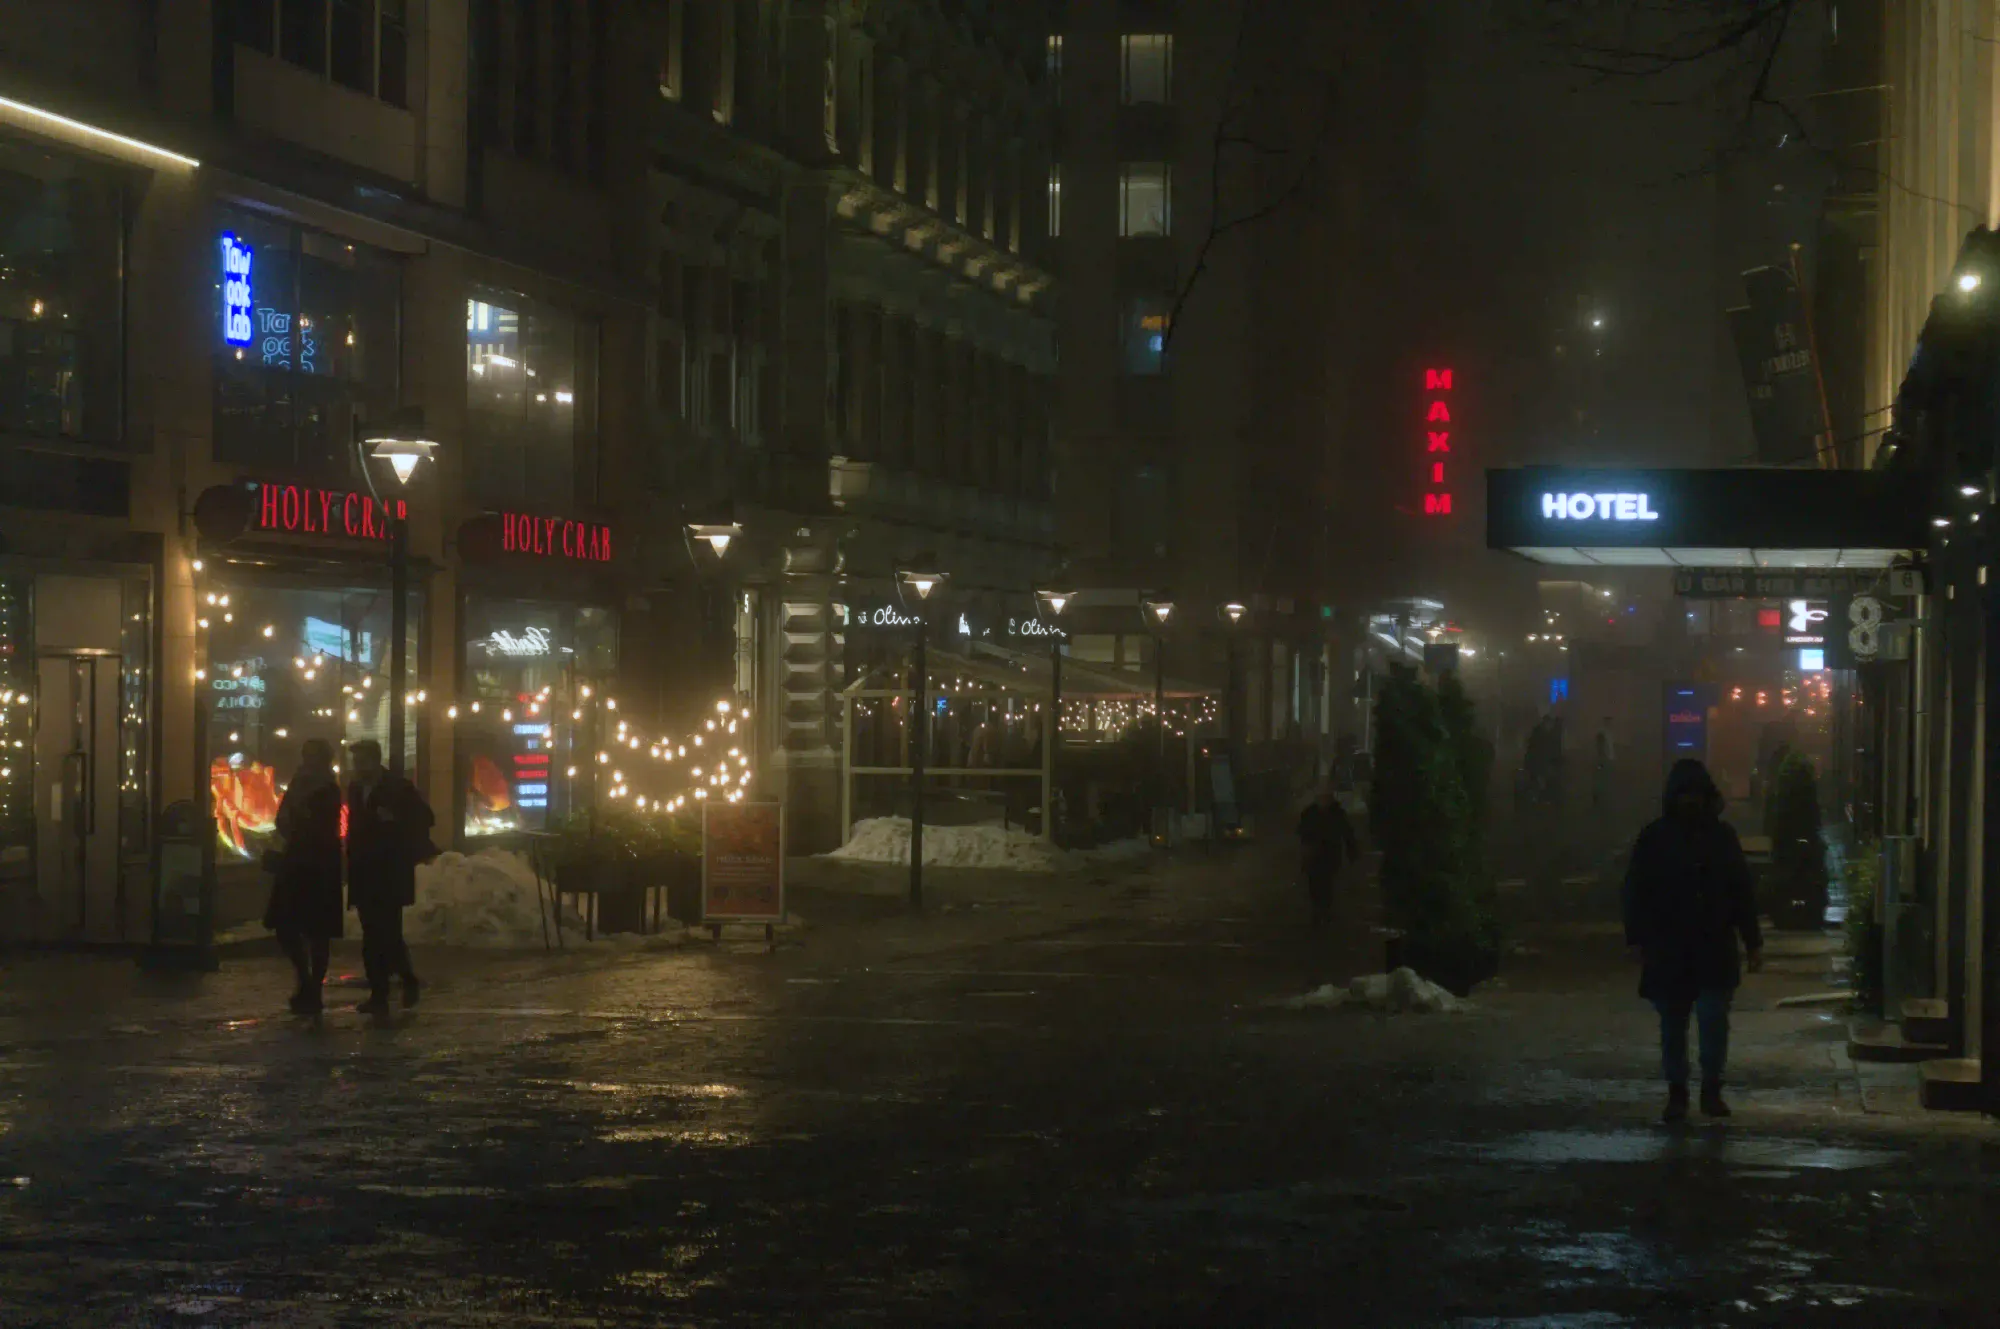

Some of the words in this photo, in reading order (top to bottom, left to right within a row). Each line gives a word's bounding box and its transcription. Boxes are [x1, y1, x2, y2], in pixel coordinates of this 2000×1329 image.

[1424, 368, 1453, 515] MAXIM
[261, 484, 333, 532] HOLY
[1541, 493, 1659, 521] HOTEL
[503, 513, 555, 555] HOLY
[563, 520, 611, 561] CRAB
